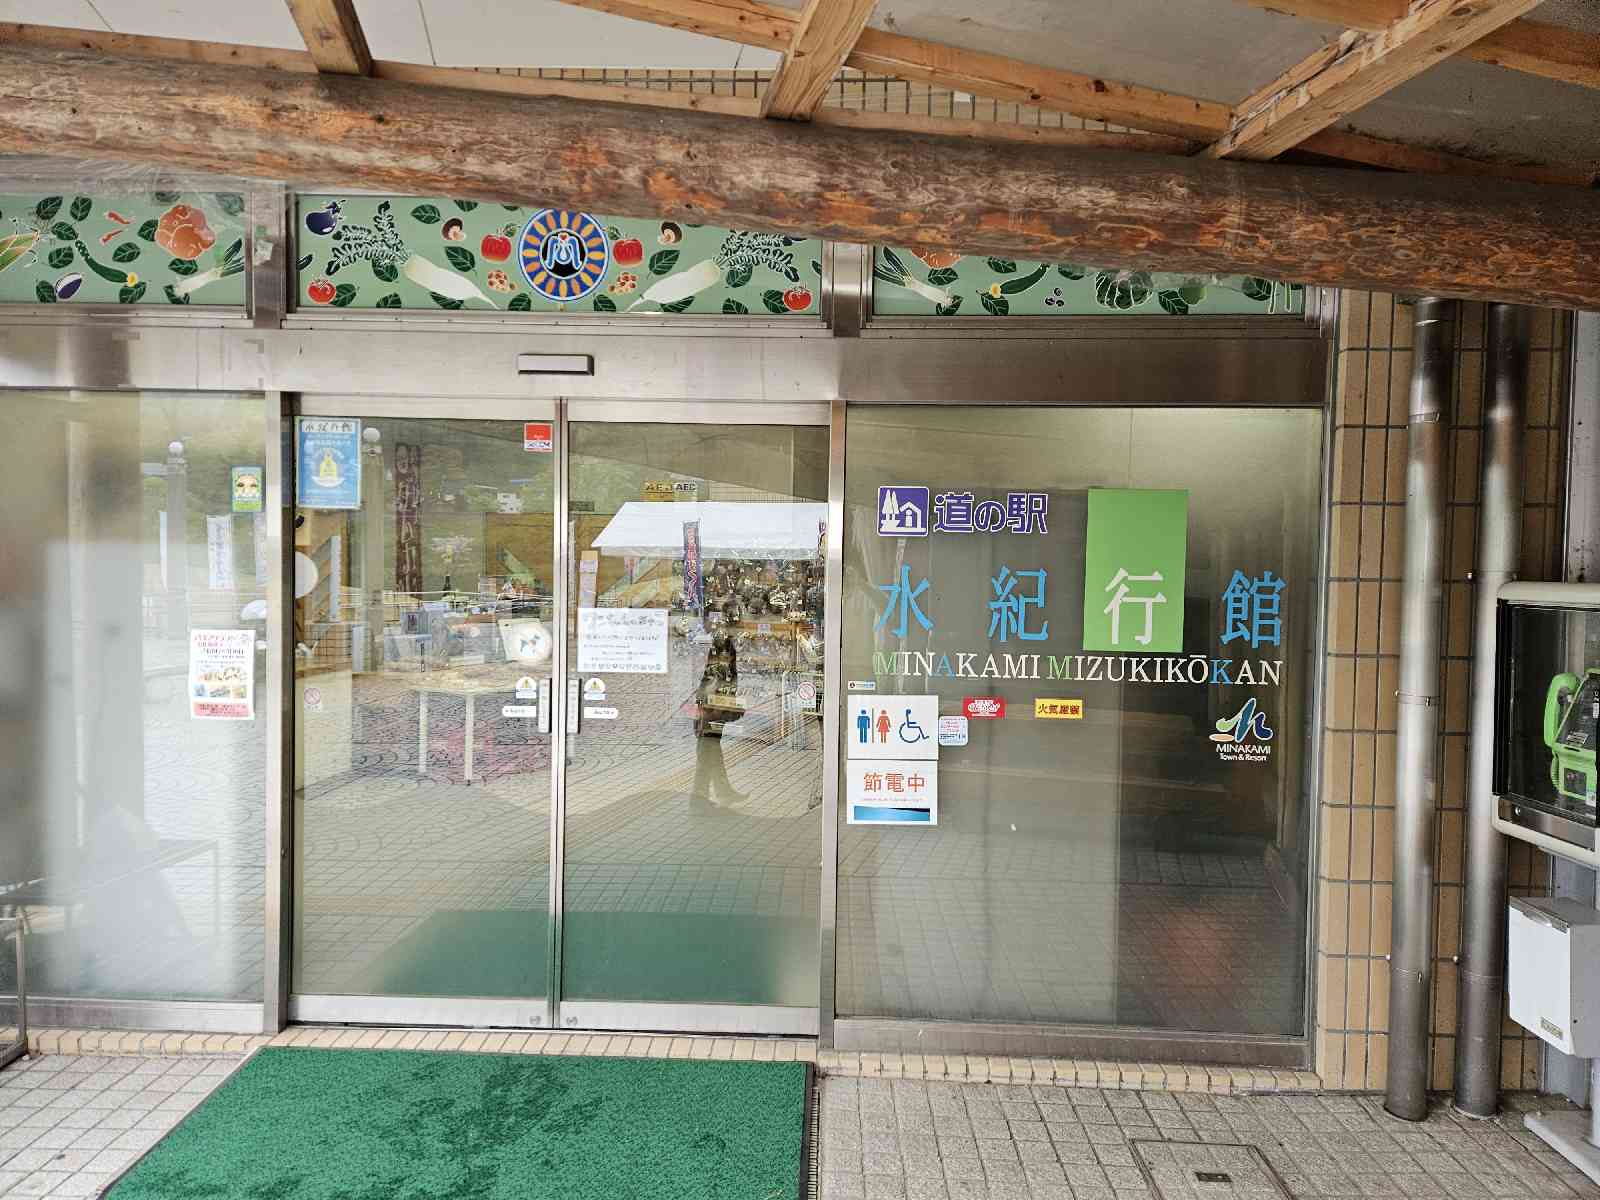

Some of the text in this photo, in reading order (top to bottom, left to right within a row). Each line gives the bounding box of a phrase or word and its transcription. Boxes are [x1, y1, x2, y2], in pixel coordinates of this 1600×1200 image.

[933, 492, 1048, 534] 道の駅
[875, 564, 1287, 649] 水紀行館
[872, 651, 1284, 686] MINAKAMI MIZUKIKŌKAN
[1215, 743, 1271, 755] MINAKAMI
[1219, 752, 1238, 761] Town
[1238, 753, 1245, 761] &
[863, 771, 926, 793] 節電中
